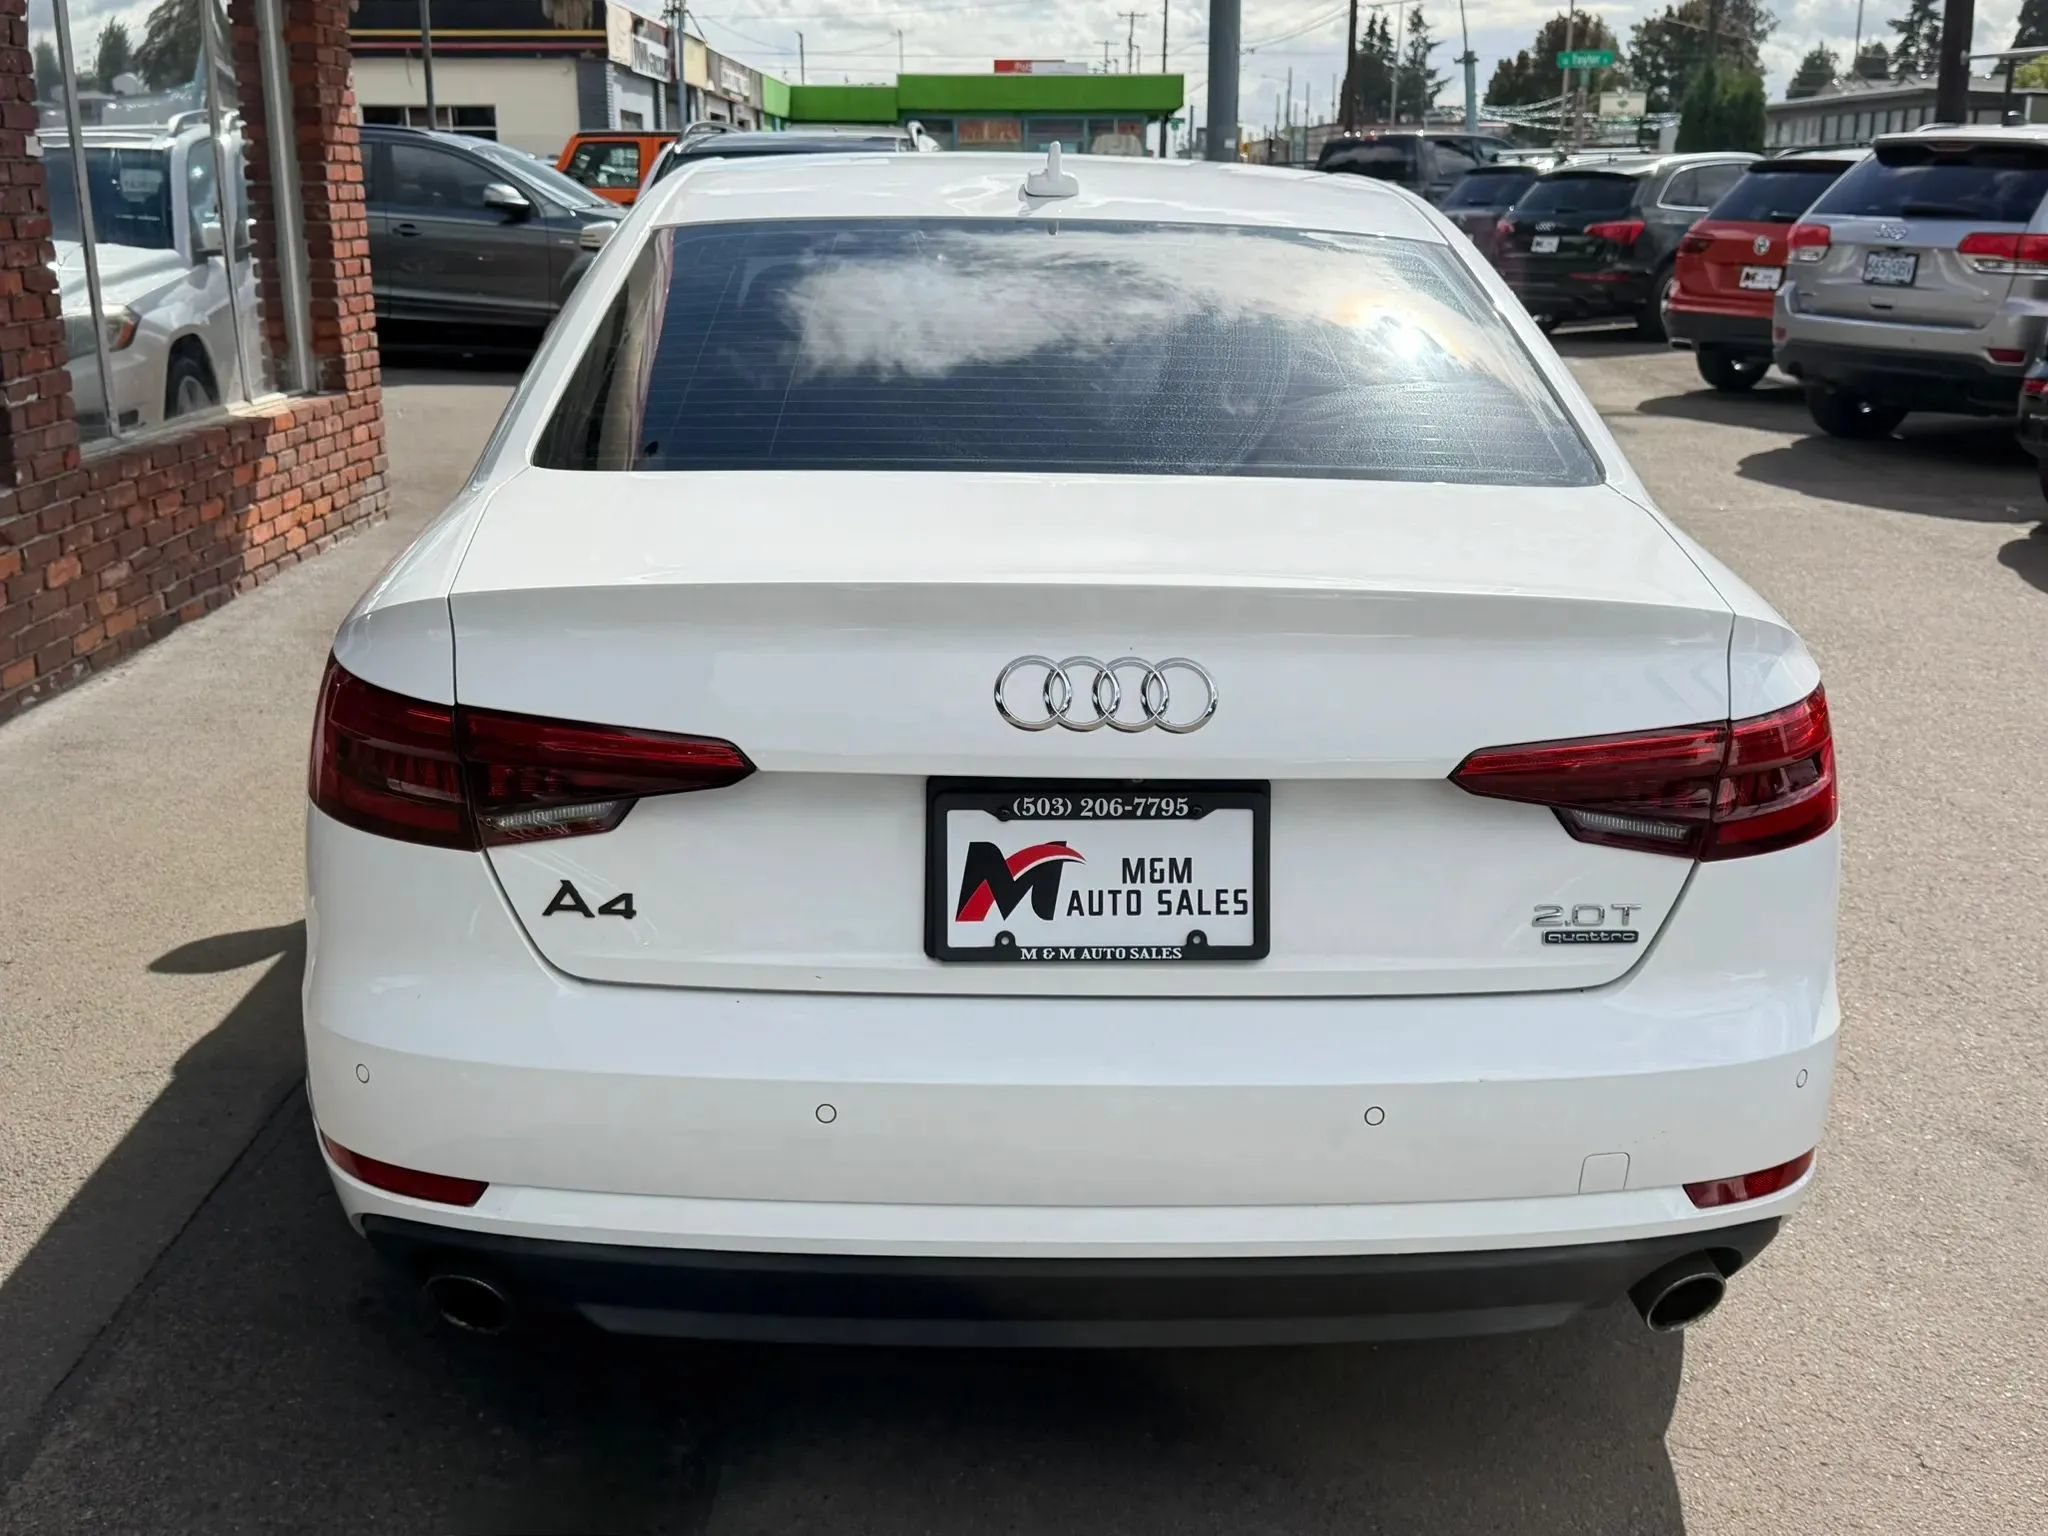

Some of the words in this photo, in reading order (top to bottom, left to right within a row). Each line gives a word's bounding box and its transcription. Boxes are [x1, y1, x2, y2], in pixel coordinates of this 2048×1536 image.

[1571, 53, 1602, 66] Taylor
[1874, 223, 1908, 241] Jeep
[1012, 796, 1073, 818] (503)
[1080, 797, 1189, 819] 206-7795
[1121, 857, 1193, 885] M&M
[541, 879, 637, 920] A4
[1066, 888, 1143, 918] AUTO
[1157, 888, 1249, 917] SALES
[1532, 902, 1643, 928] 2.0T
[1547, 931, 1636, 944] quattro
[1020, 947, 1038, 960] M
[1042, 947, 1056, 960] &
[1059, 947, 1078, 960] M
[1081, 947, 1126, 960] AUTO
[1130, 947, 1183, 960] SALES
